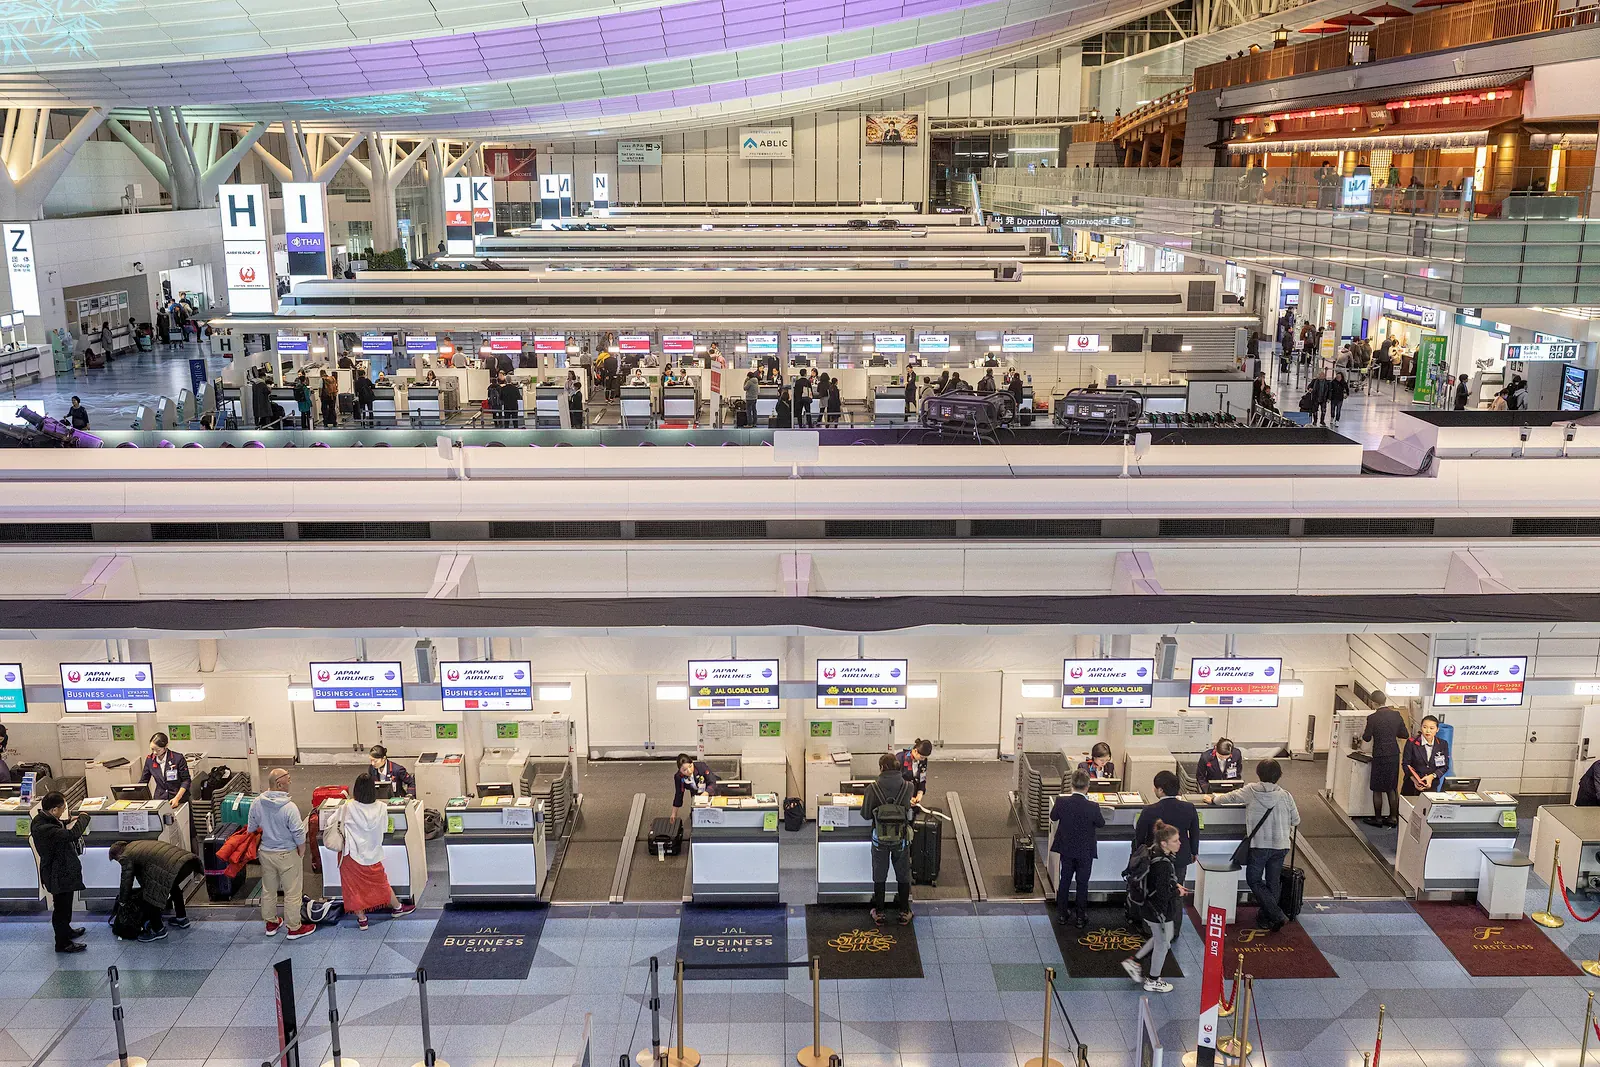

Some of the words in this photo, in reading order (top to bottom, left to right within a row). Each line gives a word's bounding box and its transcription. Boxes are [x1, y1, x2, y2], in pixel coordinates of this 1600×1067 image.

[546, 179, 555, 193] L
[596, 177, 605, 188] N
[453, 184, 461, 203] J
[473, 182, 488, 200] K
[228, 195, 256, 227] H
[299, 195, 307, 223] I
[1017, 218, 1059, 226] Departures
[10, 230, 27, 252] Z
[220, 339, 231, 351] H
[1210, 914, 1222, 938] 出口
[444, 938, 524, 946] BUSINESS
[694, 938, 773, 946] BUSINESS
